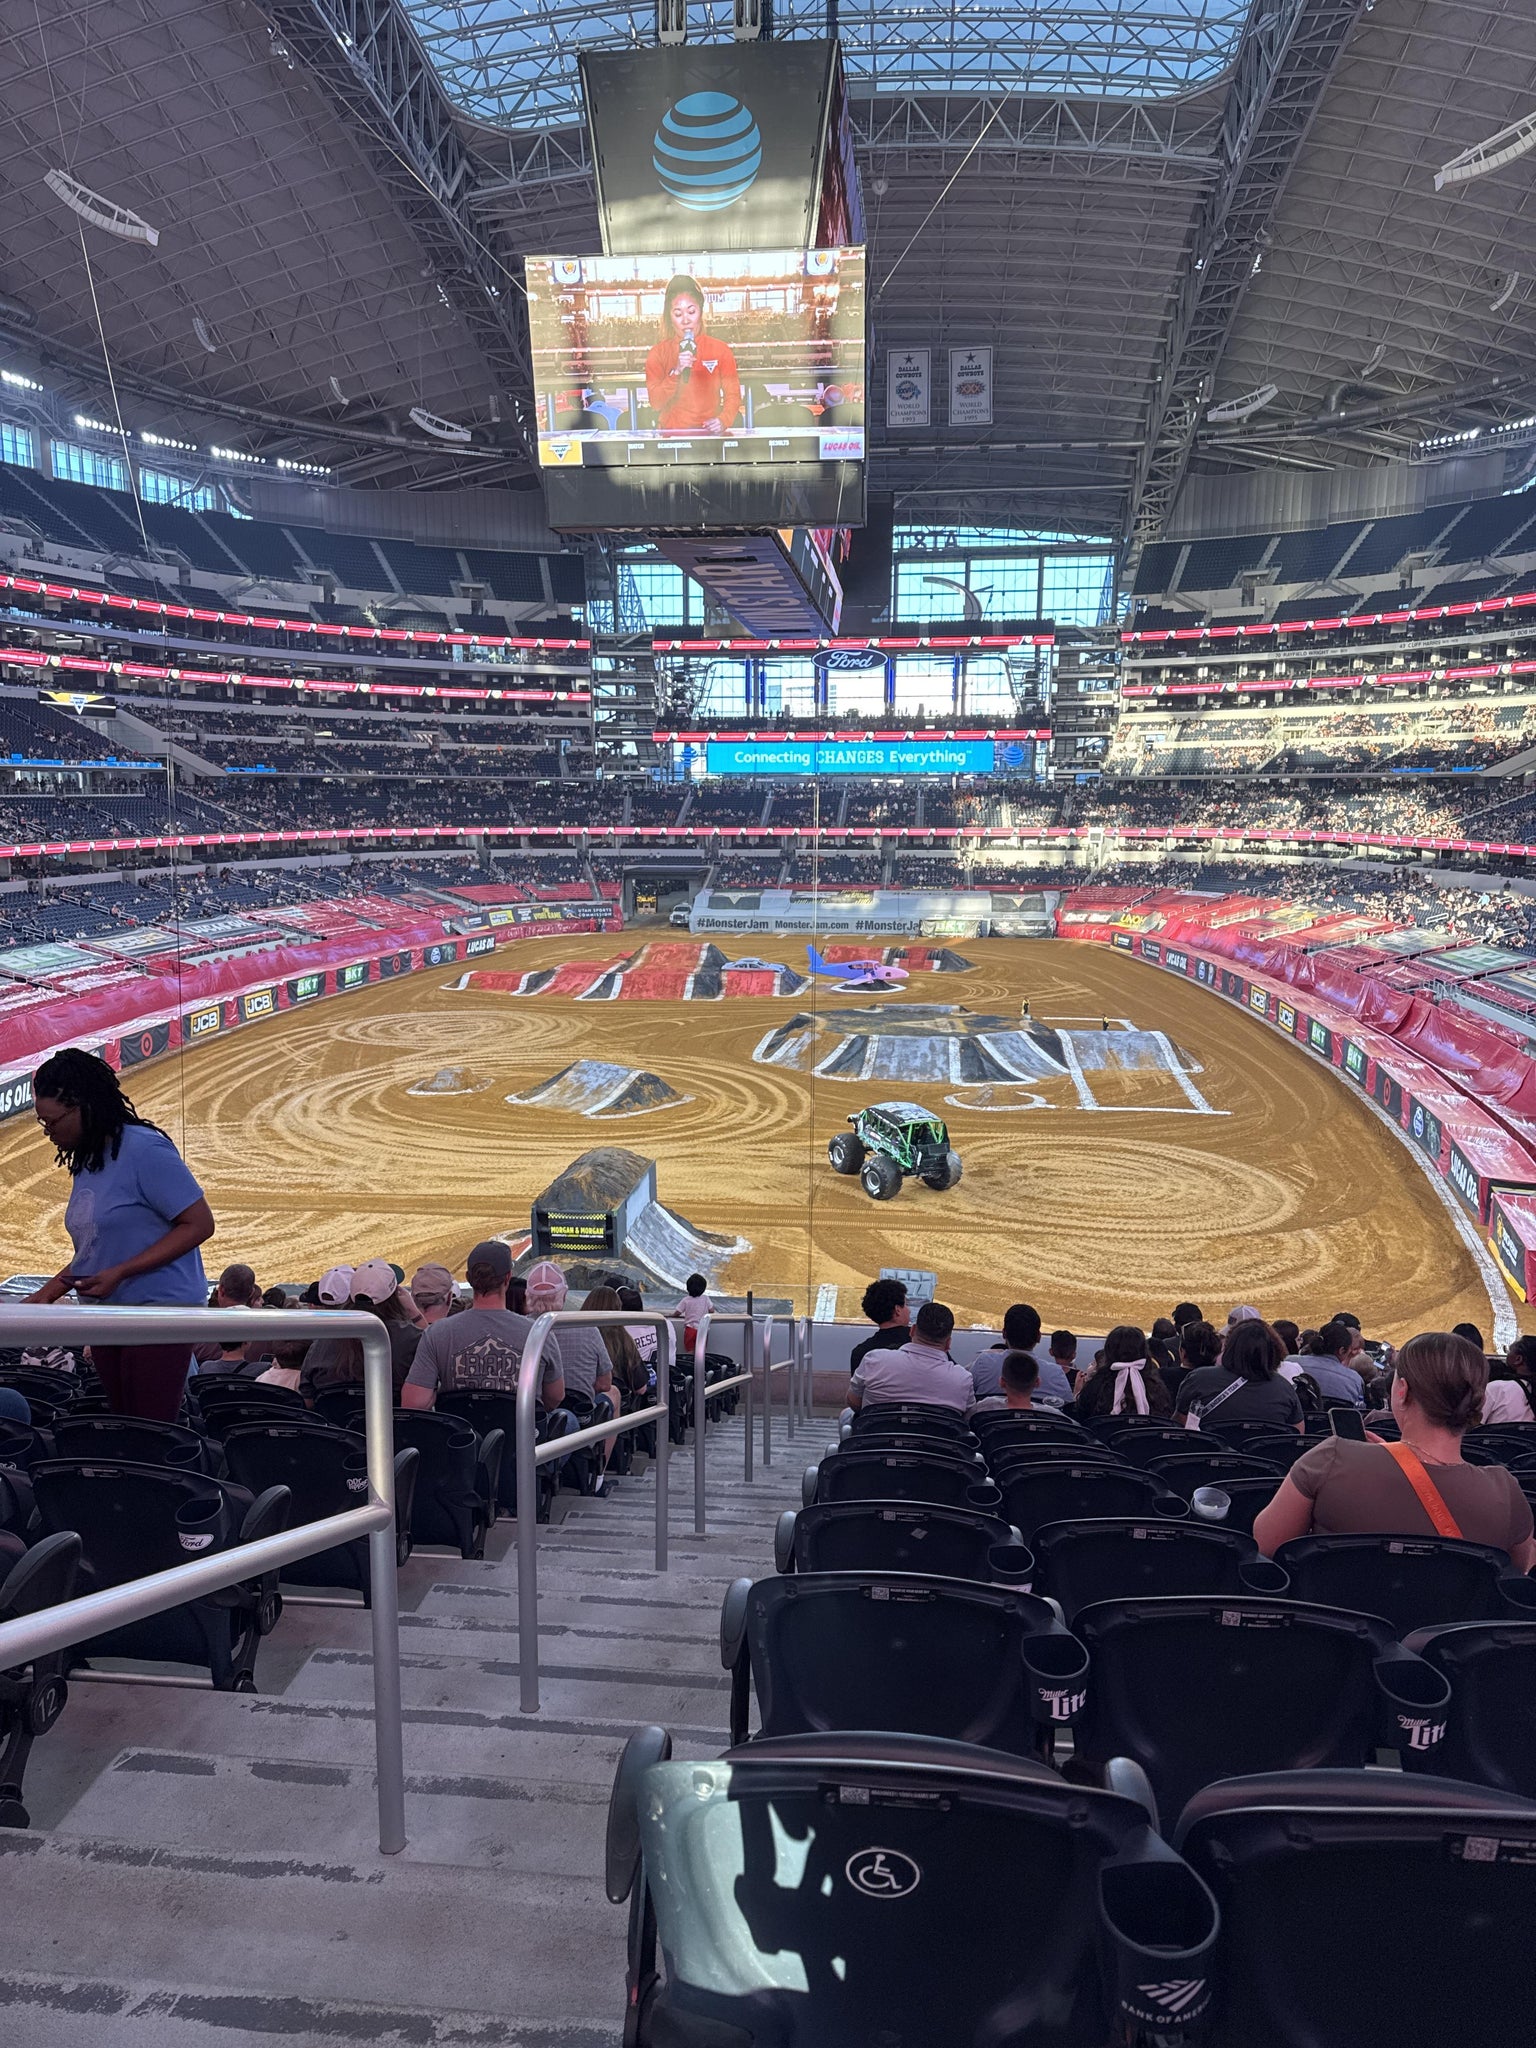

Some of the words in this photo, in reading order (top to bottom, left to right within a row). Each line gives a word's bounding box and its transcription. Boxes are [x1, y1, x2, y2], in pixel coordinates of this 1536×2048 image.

[823, 442, 847, 450] LUCAS
[848, 441, 861, 450] OIL
[826, 650, 873, 669] Ford
[734, 750, 811, 766] Connecting
[815, 750, 885, 765] CHANGES
[696, 918, 769, 929] #MonsterJam
[774, 919, 849, 930] MonsterJam.com
[855, 919, 919, 931] #MonsterJa
[466, 939, 486, 954] LUCAS
[486, 937, 496, 949] OIL
[1166, 952, 1180, 968] LUCAS
[345, 967, 364, 981] BKT
[297, 977, 319, 995] BKT
[247, 995, 272, 1014] JCB
[1252, 991, 1266, 1009] JCB
[193, 1012, 219, 1033] JCB
[1280, 1009, 1294, 1028] JCB
[1311, 1023, 1326, 1045] BKT
[1346, 1047, 1363, 1072] BKT
[14, 1081, 32, 1107] OIL
[1451, 1150, 1468, 1192] LUCAS
[550, 1226, 575, 1234] MORGAN
[580, 1226, 604, 1235] MORGAN
[634, 1332, 657, 1349] RESC
[180, 1536, 204, 1548] Ford
[265, 1600, 276, 1625] 11
[1038, 1687, 1069, 1701] Miller
[38, 1687, 57, 1723] 12
[1397, 1714, 1431, 1728] Miller
[1121, 2000, 1153, 2022] BANK
[1156, 2015, 1172, 2024] OF
